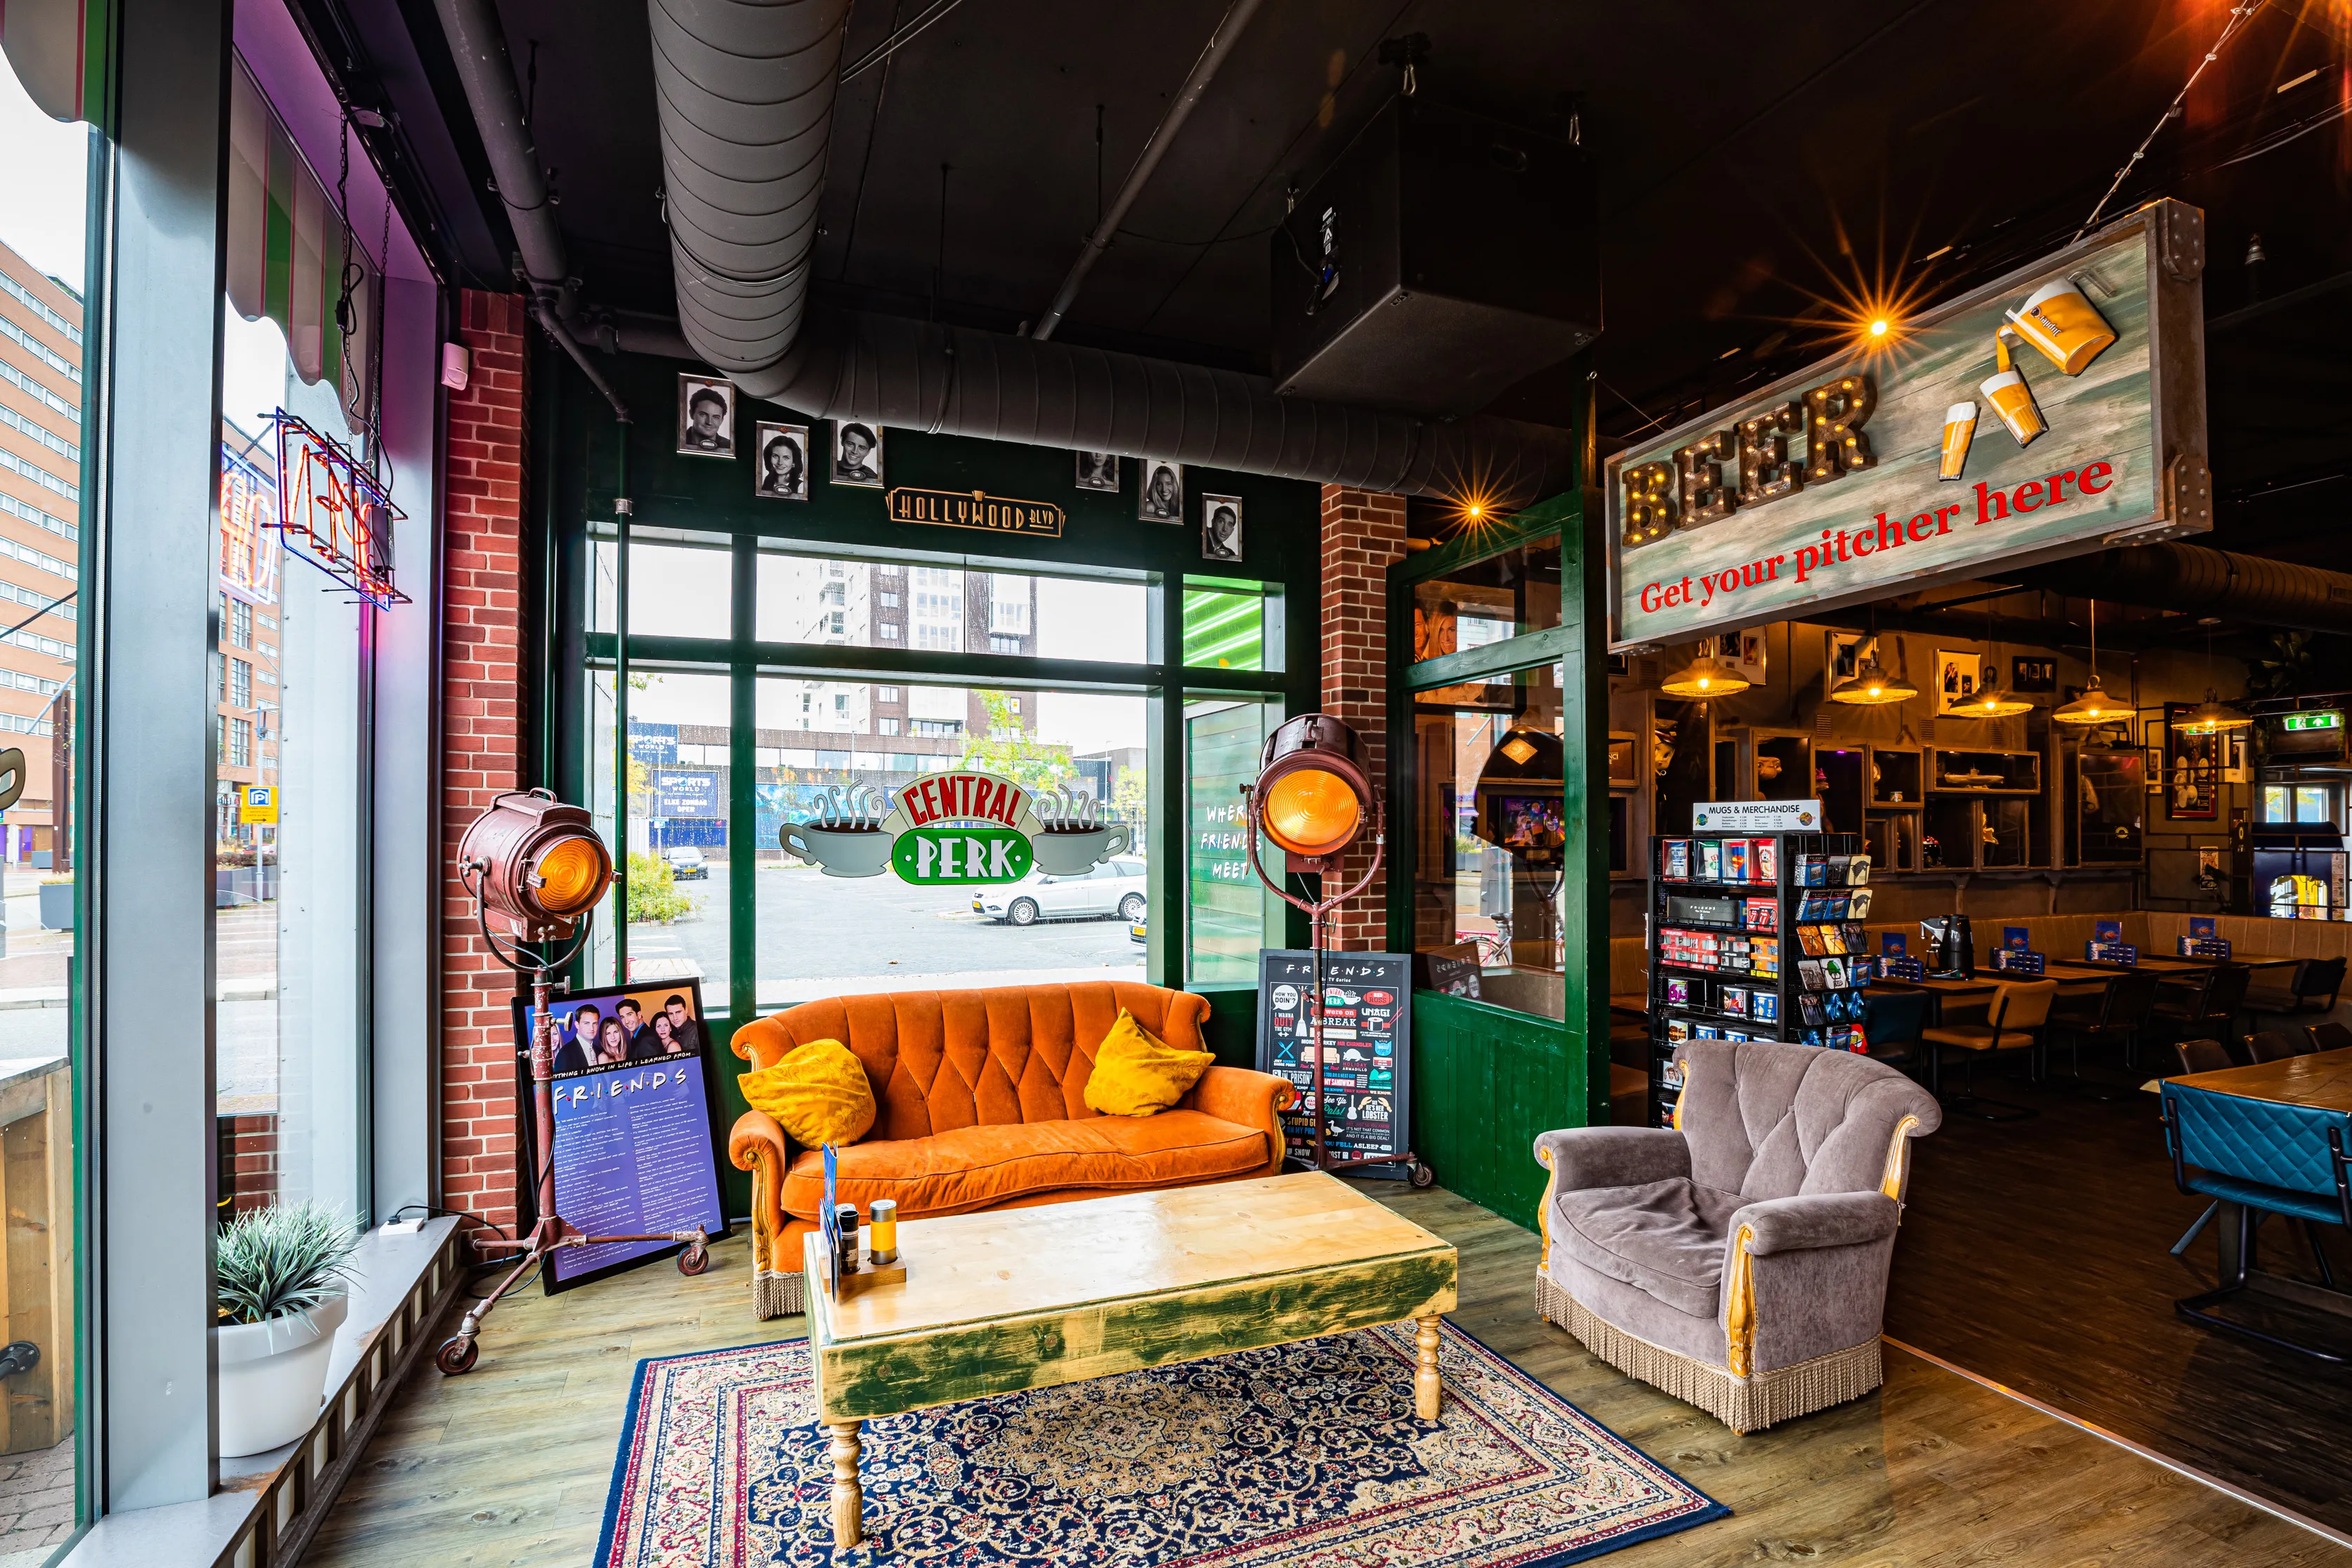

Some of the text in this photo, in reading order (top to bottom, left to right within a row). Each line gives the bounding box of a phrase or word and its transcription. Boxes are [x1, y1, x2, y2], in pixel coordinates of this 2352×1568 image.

[2039, 315, 2062, 337] Jupiler
[1622, 376, 1878, 547] BEER
[899, 495, 1054, 529] HOLLYWOOD BLVD
[1641, 461, 2113, 613] Get your pitcher here
[661, 777, 711, 786] SPORTS
[902, 775, 1021, 827] CENTRAL
[1709, 806, 1732, 815] MUGS
[1742, 805, 1800, 814] MERCHANDISE
[915, 836, 1017, 878] PERK
[1213, 862, 1248, 881] MEET
[1286, 964, 1385, 977] FRENDS
[1325, 987, 1343, 996] ENTRAL
[1361, 1008, 1391, 1017] UNAGI
[1274, 1017, 1294, 1027] QUIT
[1323, 1017, 1357, 1027] BREAK
[586, 1066, 605, 1074] KNOW
[640, 1055, 671, 1065] LEARNED
[1336, 1097, 1347, 1106] Ya
[1362, 1110, 1388, 1120] LOBSTER
[1294, 1148, 1311, 1157] SNOW
